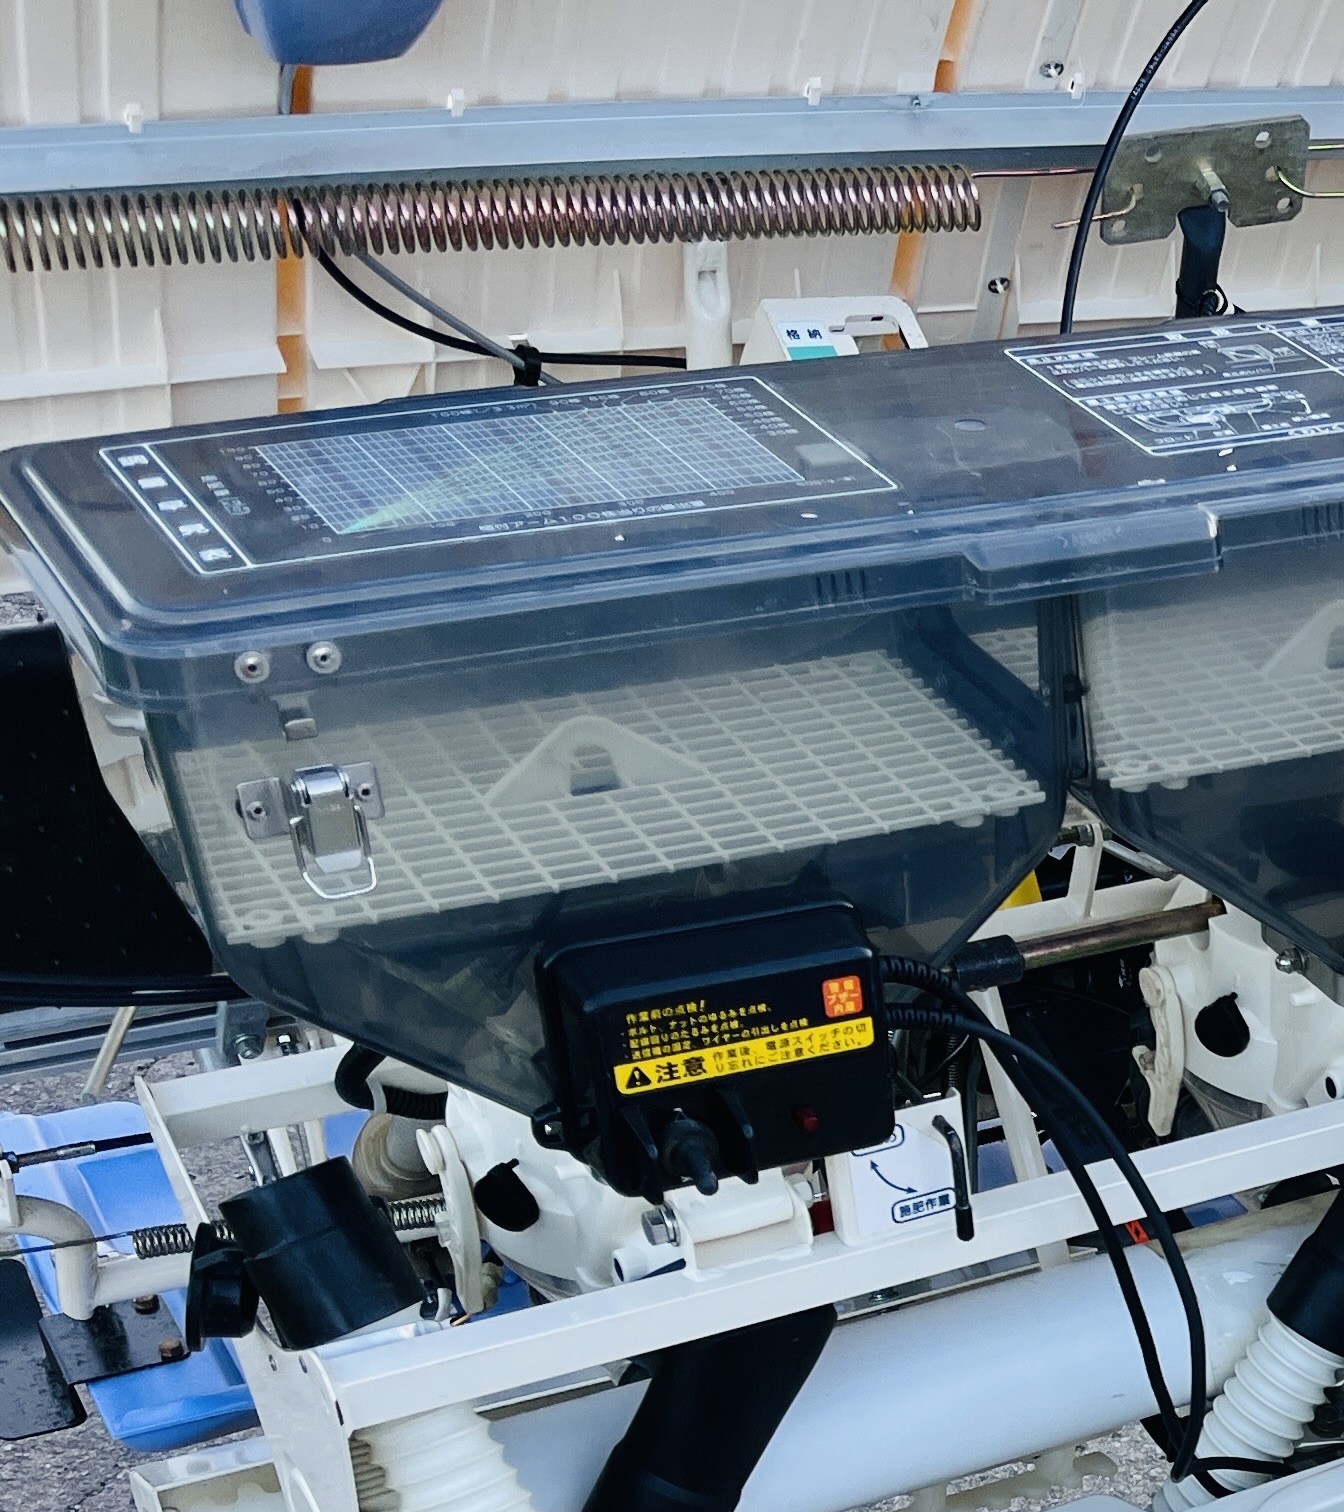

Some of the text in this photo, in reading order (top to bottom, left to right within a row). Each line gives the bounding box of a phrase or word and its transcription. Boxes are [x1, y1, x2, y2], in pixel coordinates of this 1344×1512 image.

[786, 328, 823, 341] 格納
[655, 1057, 707, 1084] 注意
[899, 1193, 951, 1219] 施肥作業
